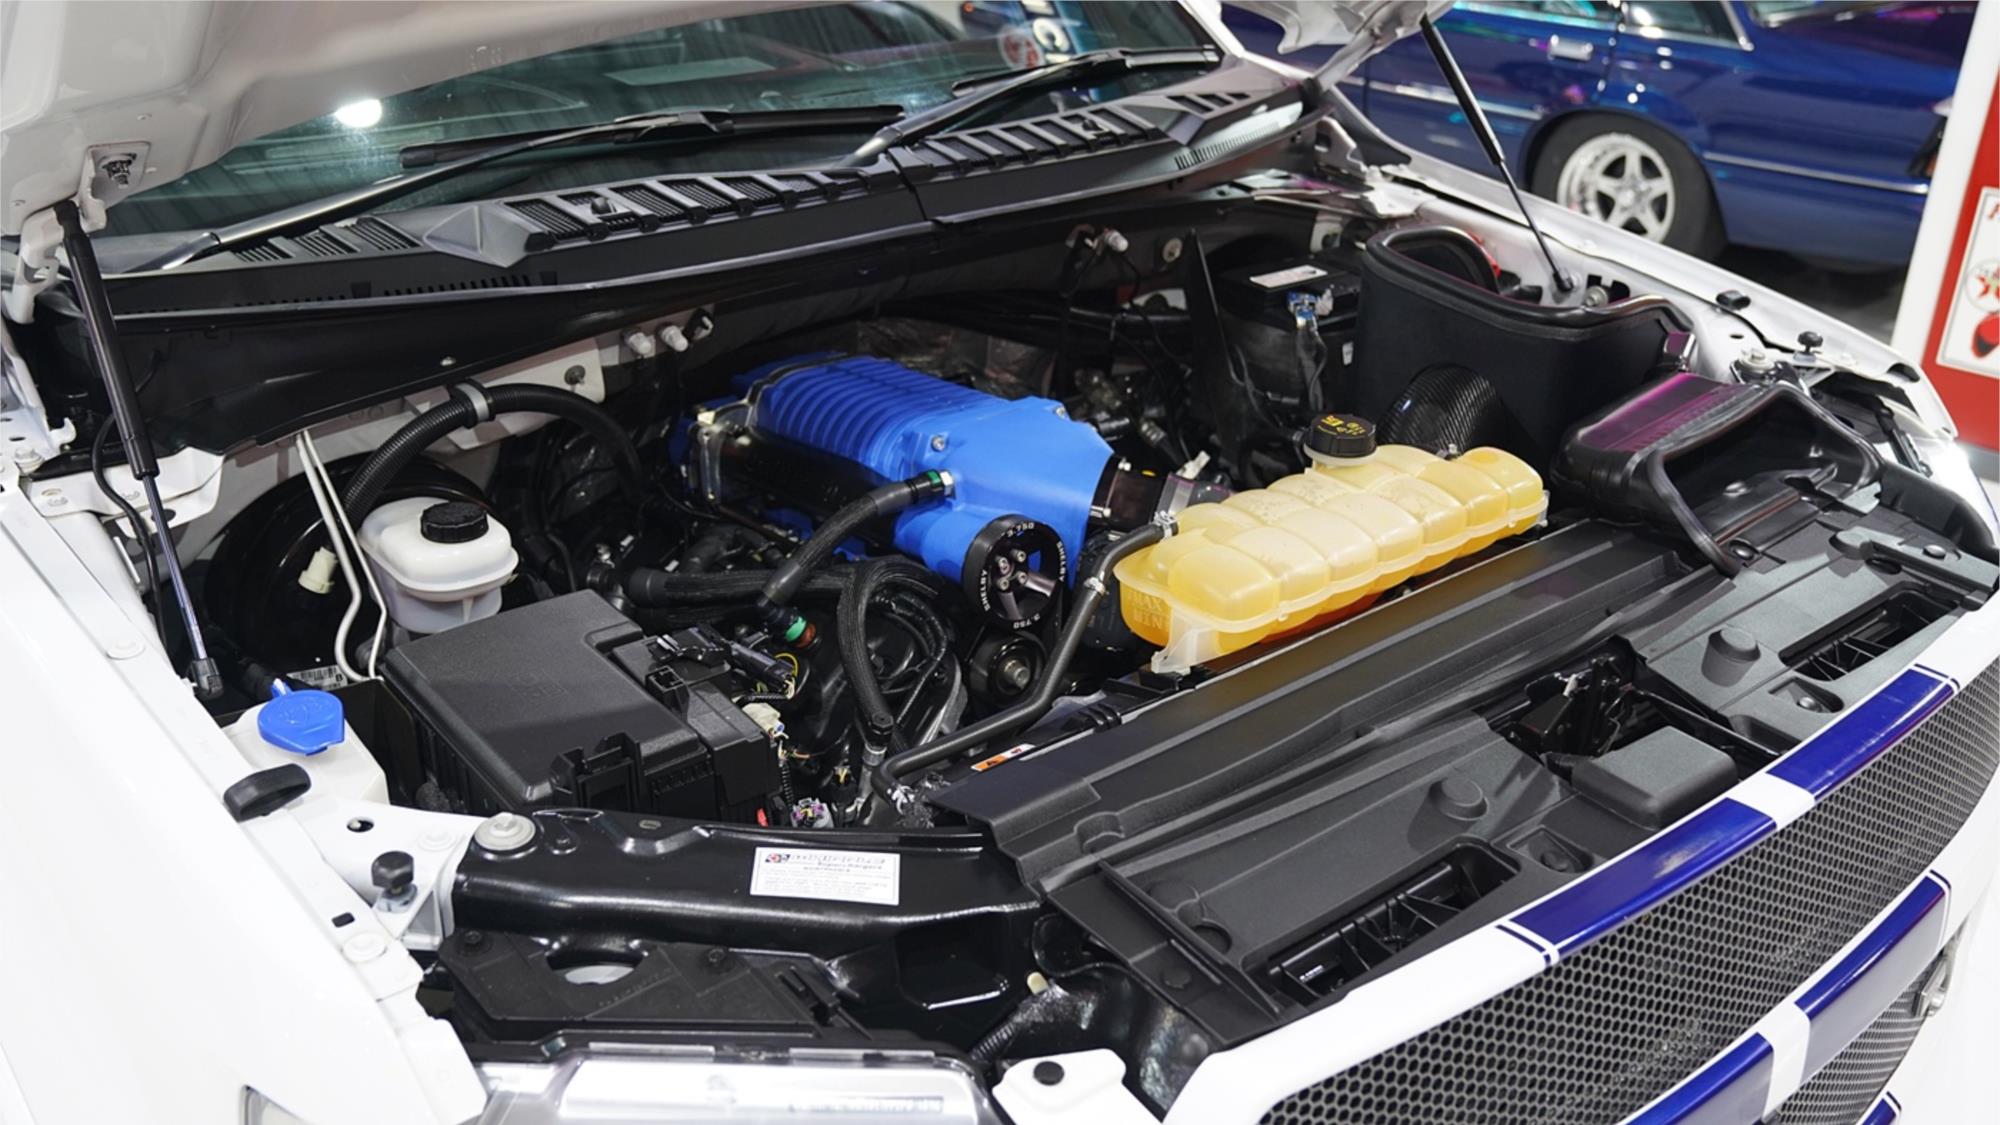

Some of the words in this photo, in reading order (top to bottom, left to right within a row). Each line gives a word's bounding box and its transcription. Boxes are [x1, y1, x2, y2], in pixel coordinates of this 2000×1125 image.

[1056, 541, 1066, 582] SHELBY
[980, 569, 991, 611] SHELBY
[1133, 611, 1162, 629] MIN
